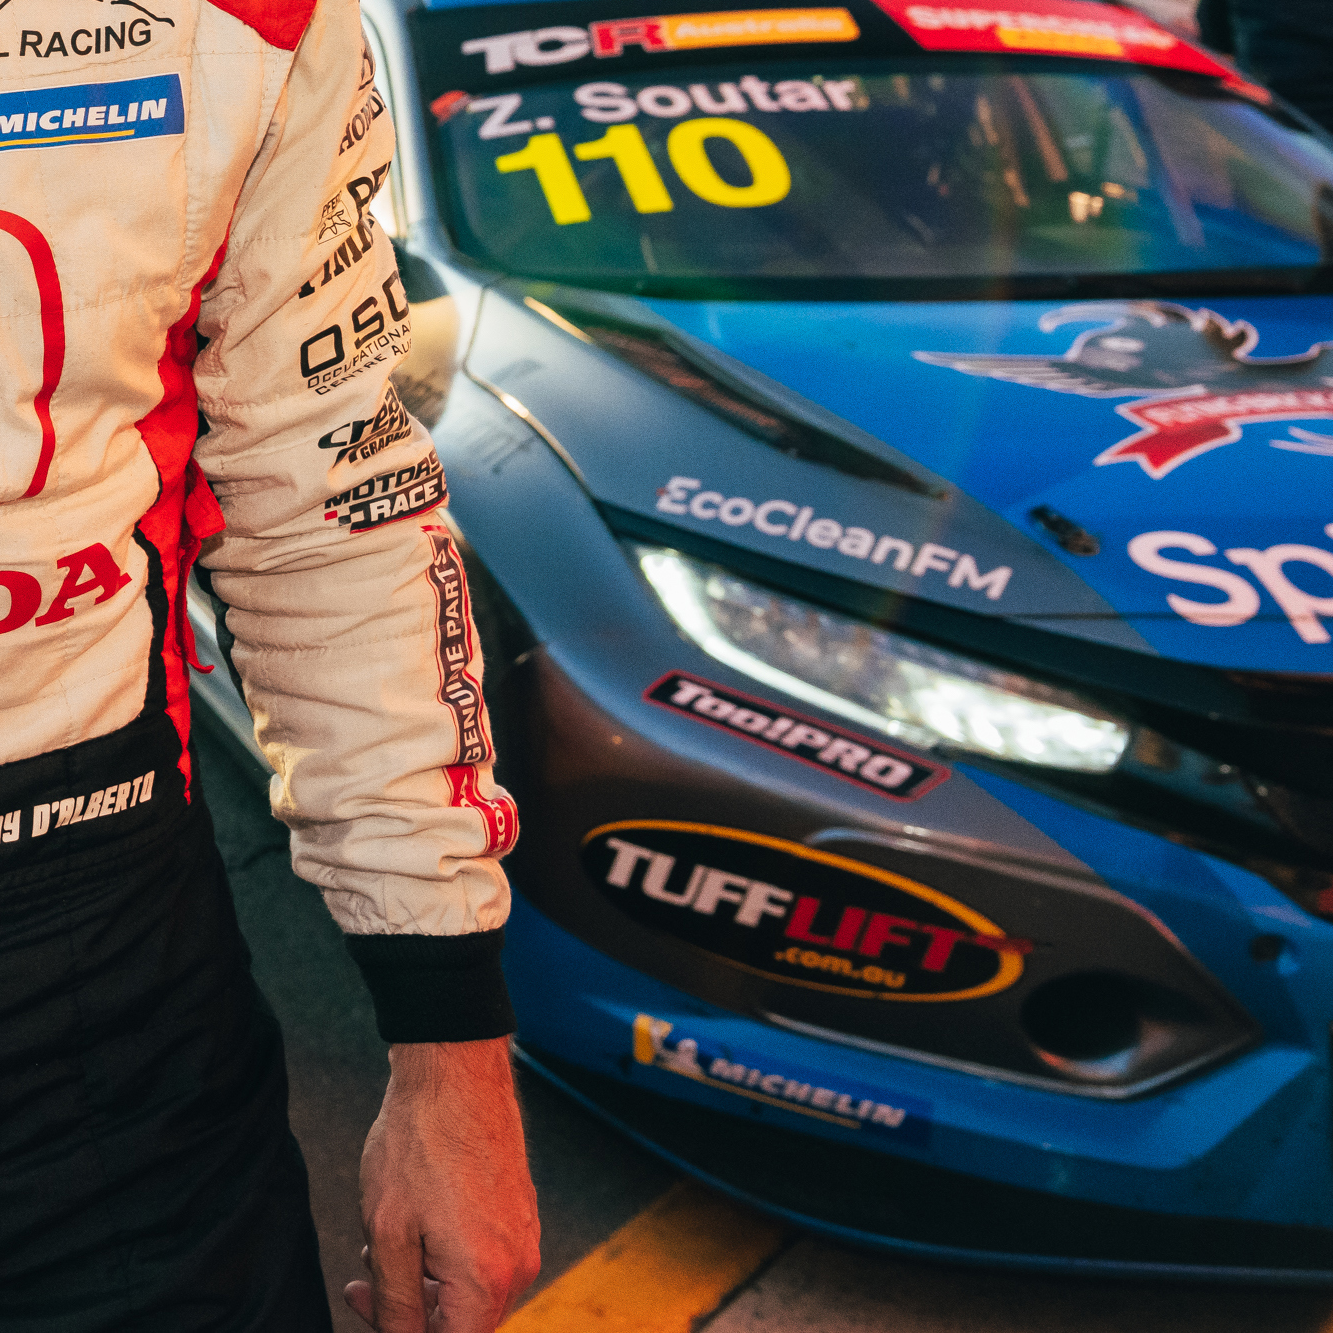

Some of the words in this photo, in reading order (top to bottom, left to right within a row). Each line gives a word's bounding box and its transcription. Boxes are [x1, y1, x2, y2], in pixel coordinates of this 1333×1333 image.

[18, 17, 152, 58] RACING
[462, 18, 671, 74] TCR
[676, 17, 843, 39] Australia
[471, 96, 555, 141] Z.
[573, 74, 857, 125] Soutar
[496, 116, 793, 226] 110
[314, 353, 388, 396] CENTRE
[369, 478, 439, 522] RACE
[655, 476, 1014, 601] EcoCleanFM
[433, 548, 462, 638] PARTS
[444, 643, 482, 764] GENUINE
[669, 677, 914, 791] ToolPRO
[31, 769, 156, 838] D'ALBERTO
[605, 837, 1033, 972] TUFFLIFT
[774, 945, 907, 990] .com.au
[710, 1057, 907, 1130] MICHELIN
